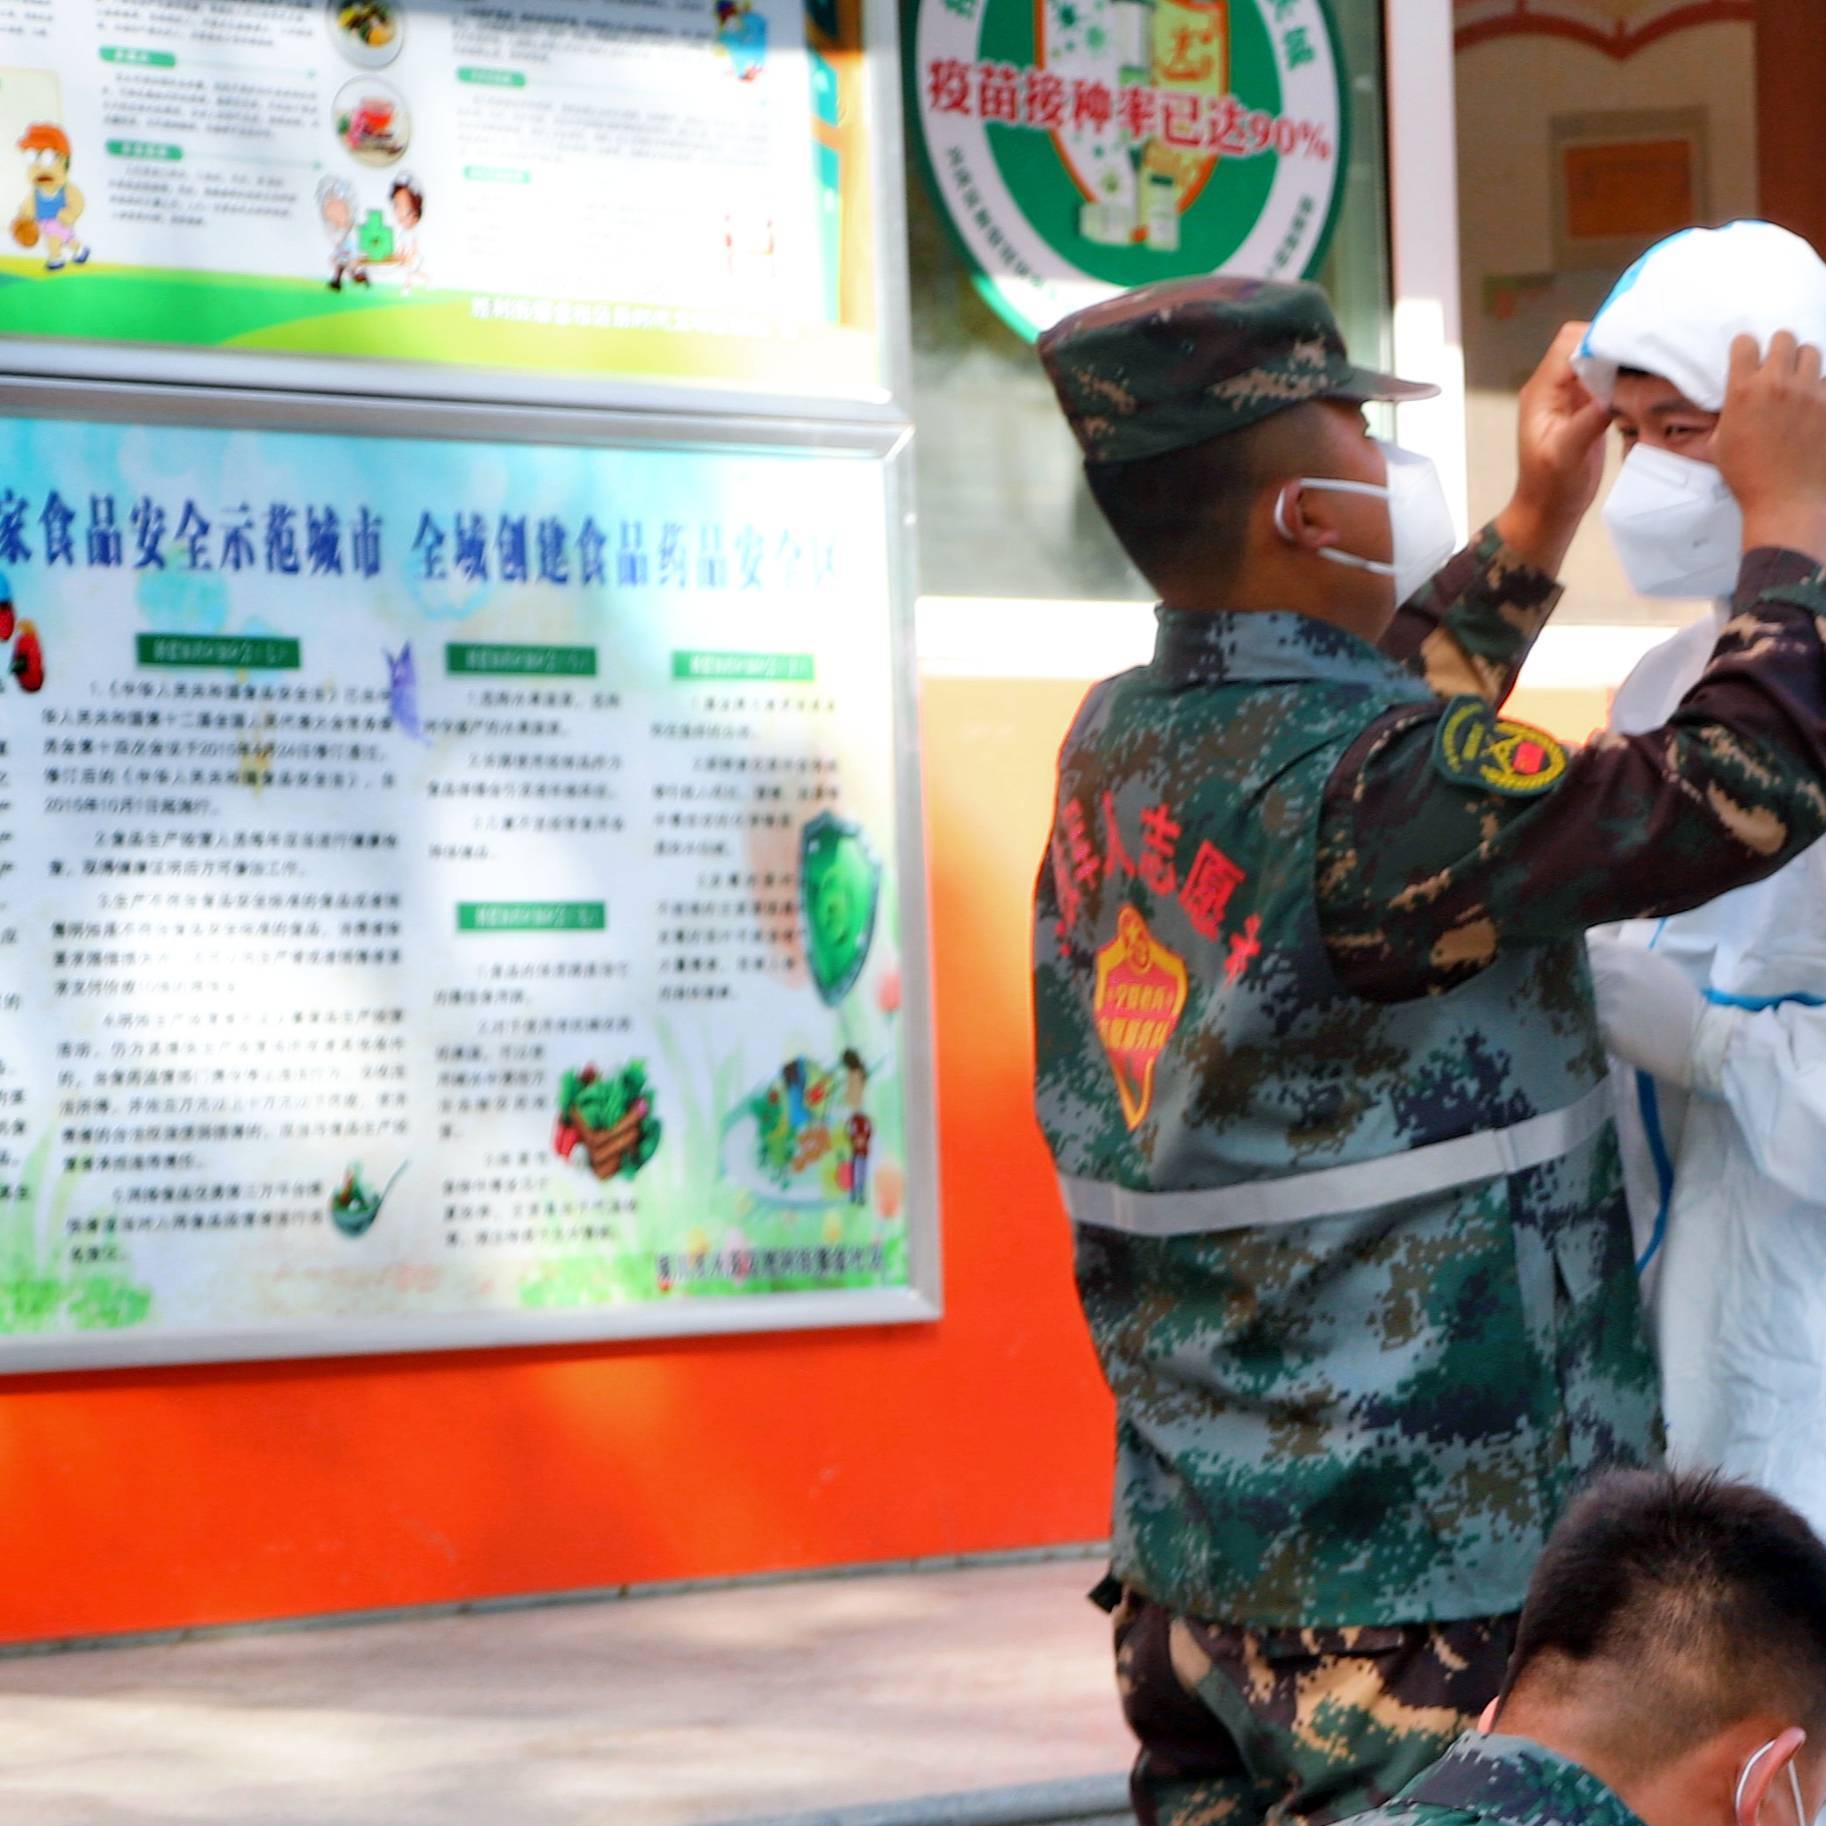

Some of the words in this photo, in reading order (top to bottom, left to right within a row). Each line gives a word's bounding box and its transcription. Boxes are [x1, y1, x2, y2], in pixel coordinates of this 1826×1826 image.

[926, 56, 1332, 162] 疫苗接种率已达90%
[0, 489, 383, 579] 家食品安全示范城市
